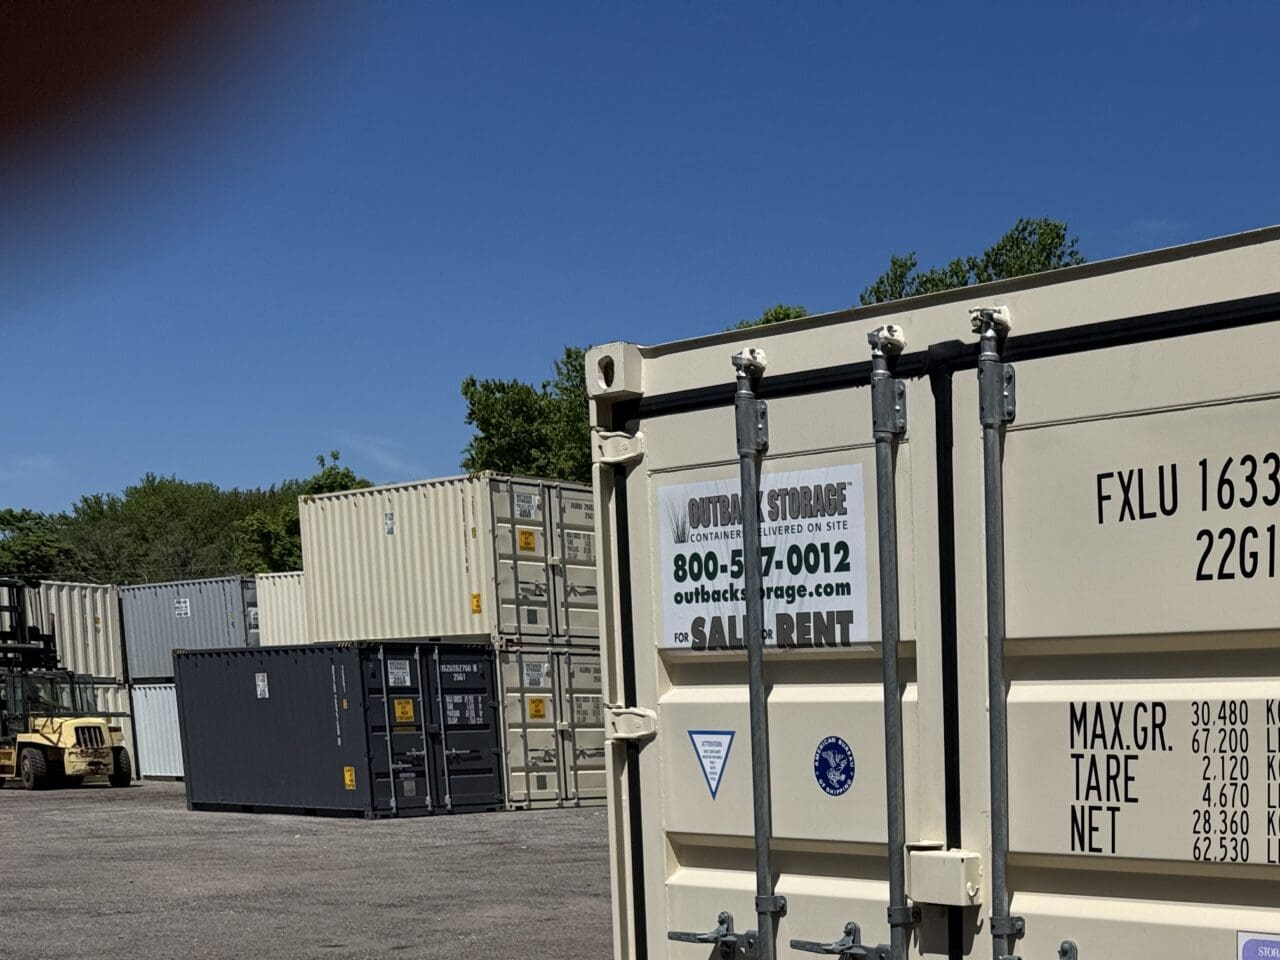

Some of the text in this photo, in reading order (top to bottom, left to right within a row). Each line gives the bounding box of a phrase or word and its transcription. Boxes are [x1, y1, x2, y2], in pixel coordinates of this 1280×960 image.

[688, 492, 766, 529] OUTBAK
[768, 482, 848, 522] STORAGE
[1096, 463, 1178, 524] FXLU
[690, 520, 849, 543] CONTAINER ELIVERED ON SITE
[1196, 524, 1276, 581] 22G1
[674, 540, 851, 583] 800-57-0012
[674, 582, 852, 605] outbacksorage.com
[674, 632, 689, 643] FOR
[691, 615, 748, 651] SAL
[776, 610, 854, 649] RENT
[1069, 701, 1173, 751] MAX.GR.
[1191, 700, 1249, 727] 30,480
[1191, 727, 1249, 754] 67,200
[1070, 753, 1139, 803] TARE
[1202, 755, 1249, 781] 2,120
[1202, 782, 1249, 809] 4,670
[1070, 805, 1121, 854] NET
[1192, 810, 1249, 835] 28,360
[1192, 836, 1249, 863] 62,530
